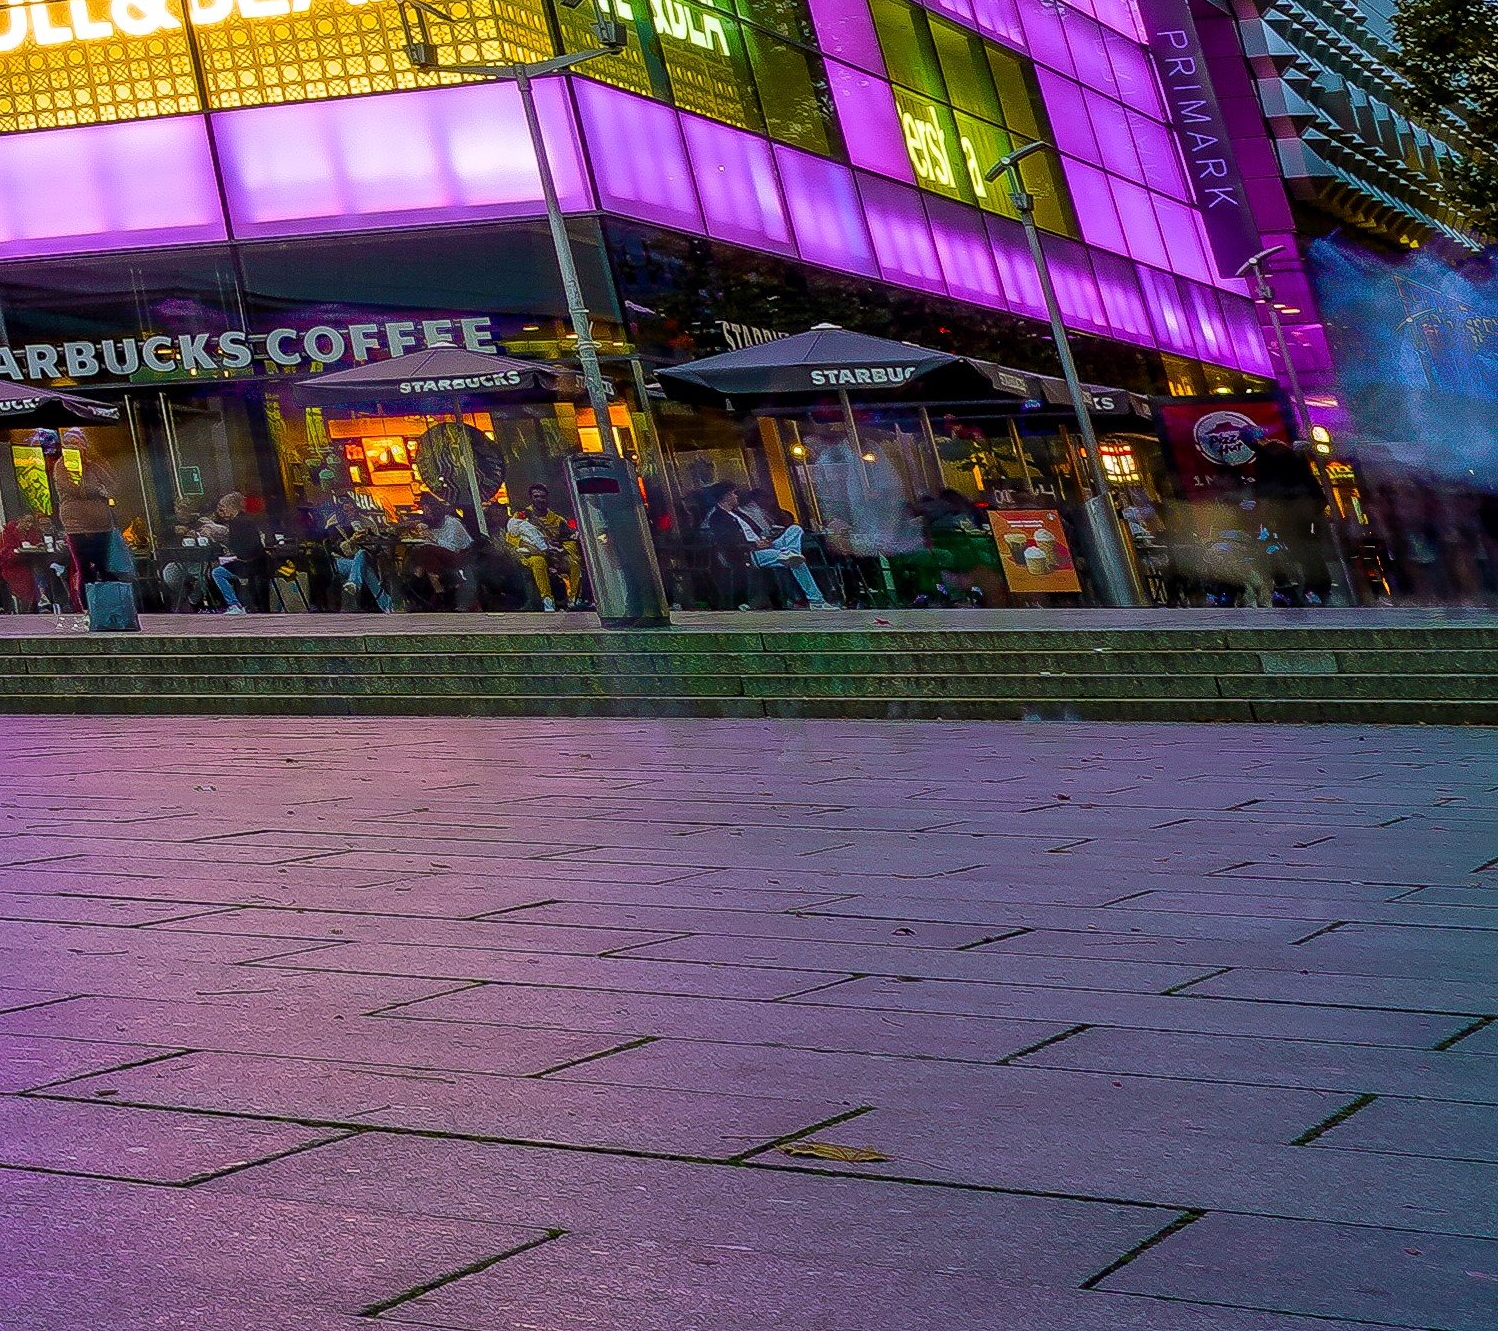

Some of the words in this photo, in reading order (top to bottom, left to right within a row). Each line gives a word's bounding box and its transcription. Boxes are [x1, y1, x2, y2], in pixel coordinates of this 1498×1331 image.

[1156, 30, 1239, 209] PRIMARK
[265, 314, 499, 368] COFFEE
[398, 369, 522, 395] STARBUCKS
